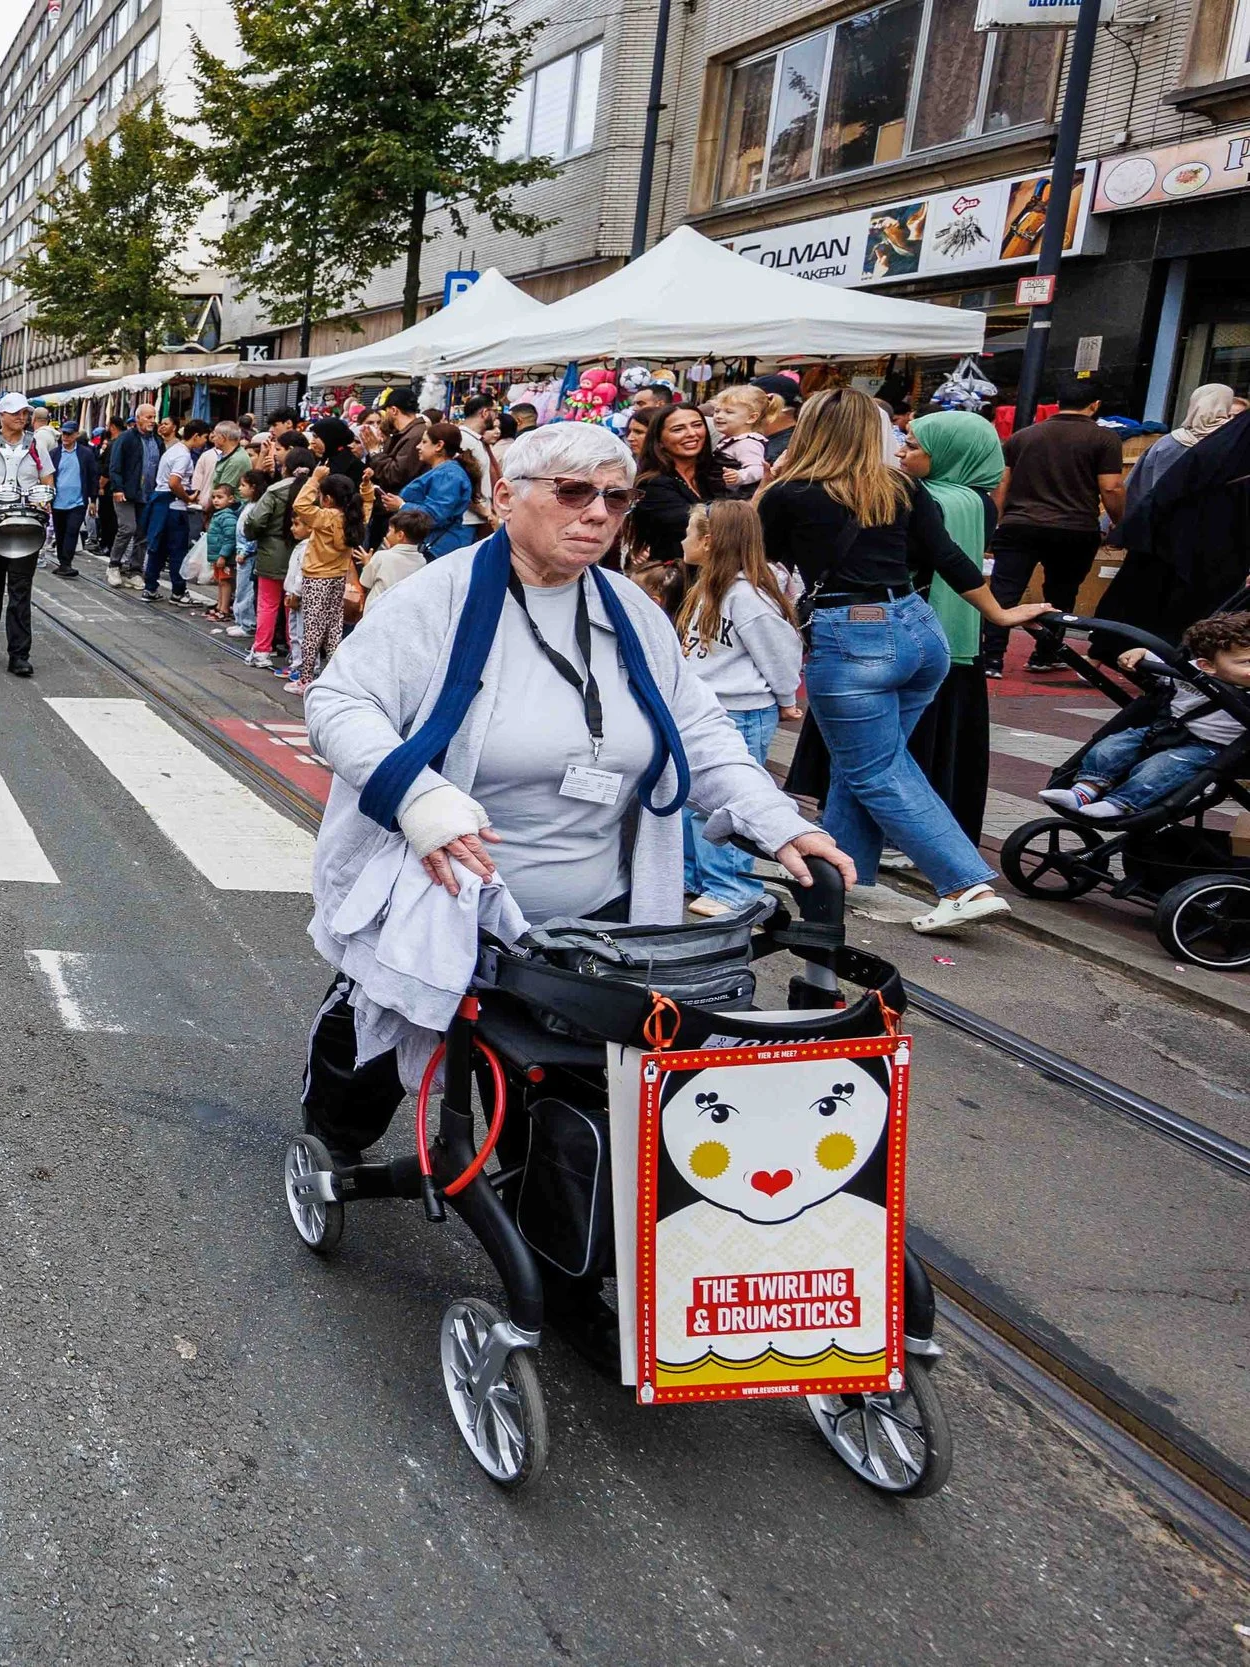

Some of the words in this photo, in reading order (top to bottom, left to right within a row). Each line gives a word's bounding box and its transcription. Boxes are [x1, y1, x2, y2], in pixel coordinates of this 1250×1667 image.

[699, 1278, 739, 1304] THE
[744, 1271, 847, 1302] TWIRLING
[693, 1308, 711, 1333] &
[717, 1299, 854, 1332] DRUMSTICKS
[741, 1384, 800, 1395] WWW.REUSKENS.BE
